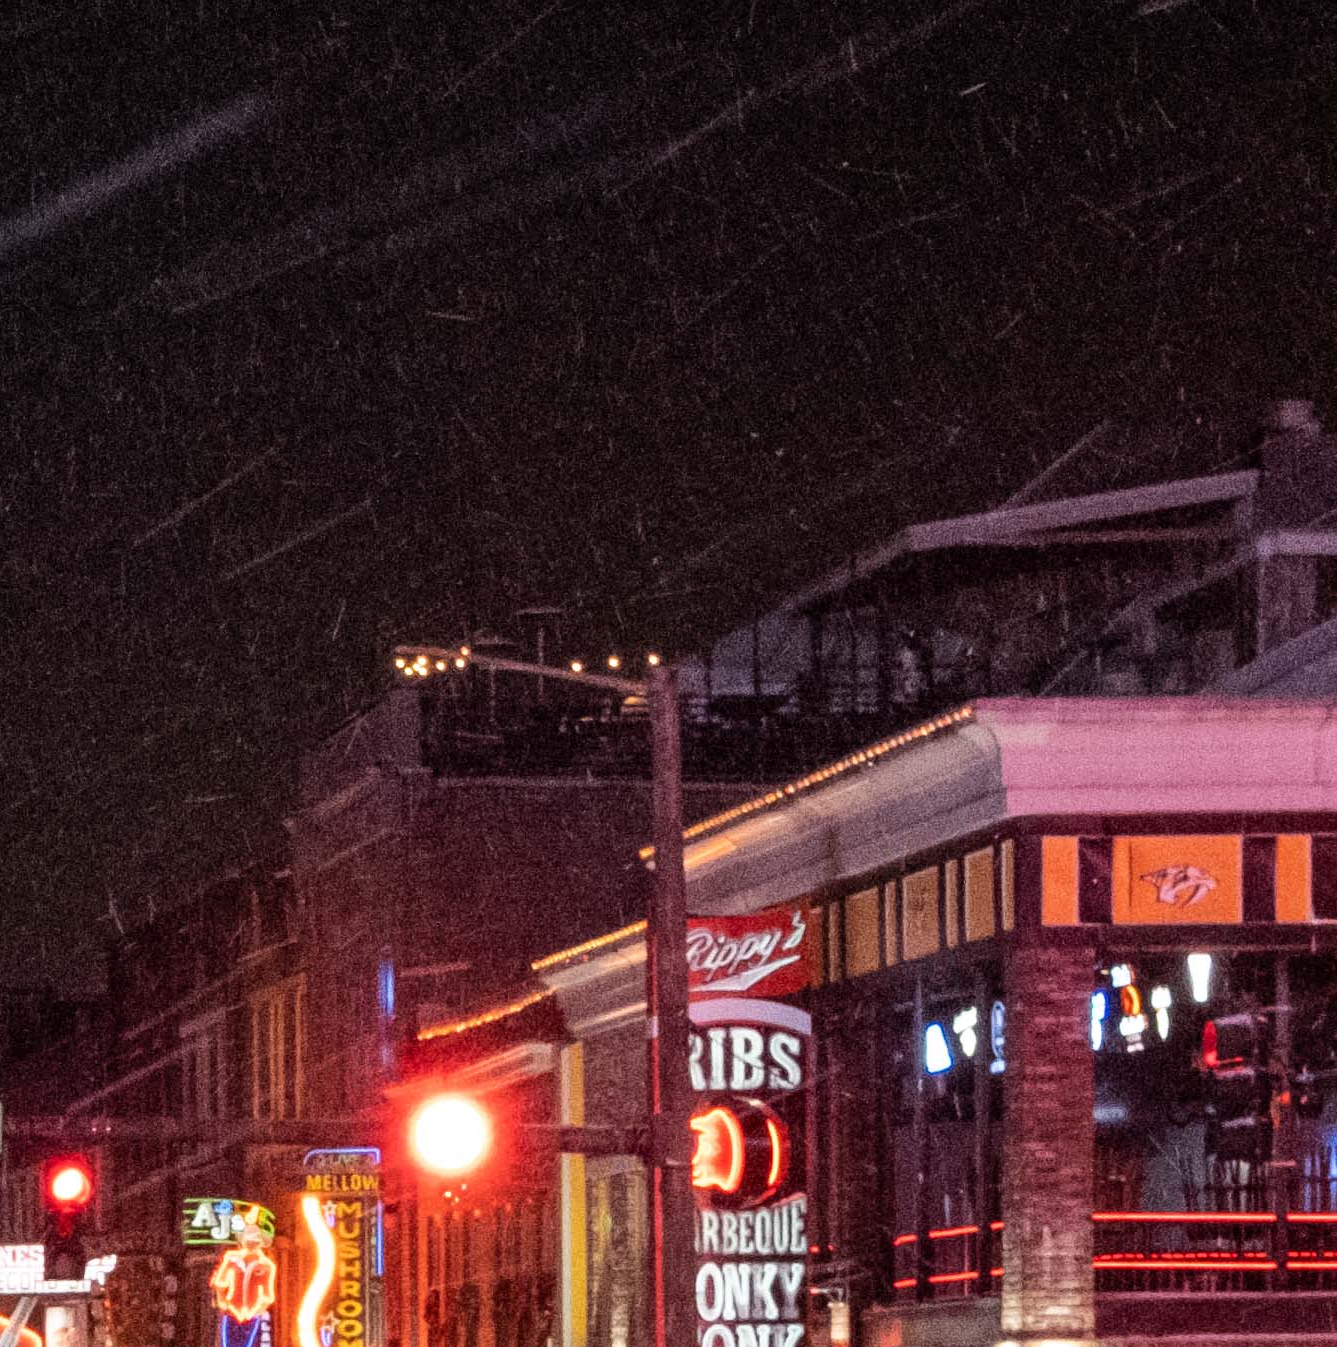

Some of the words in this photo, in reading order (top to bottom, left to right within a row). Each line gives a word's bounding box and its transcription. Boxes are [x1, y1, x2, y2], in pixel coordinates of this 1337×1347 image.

[686, 911, 806, 983] Rippy's
[306, 1174, 381, 1191] MELLOW
[696, 1262, 805, 1321] ONKY
